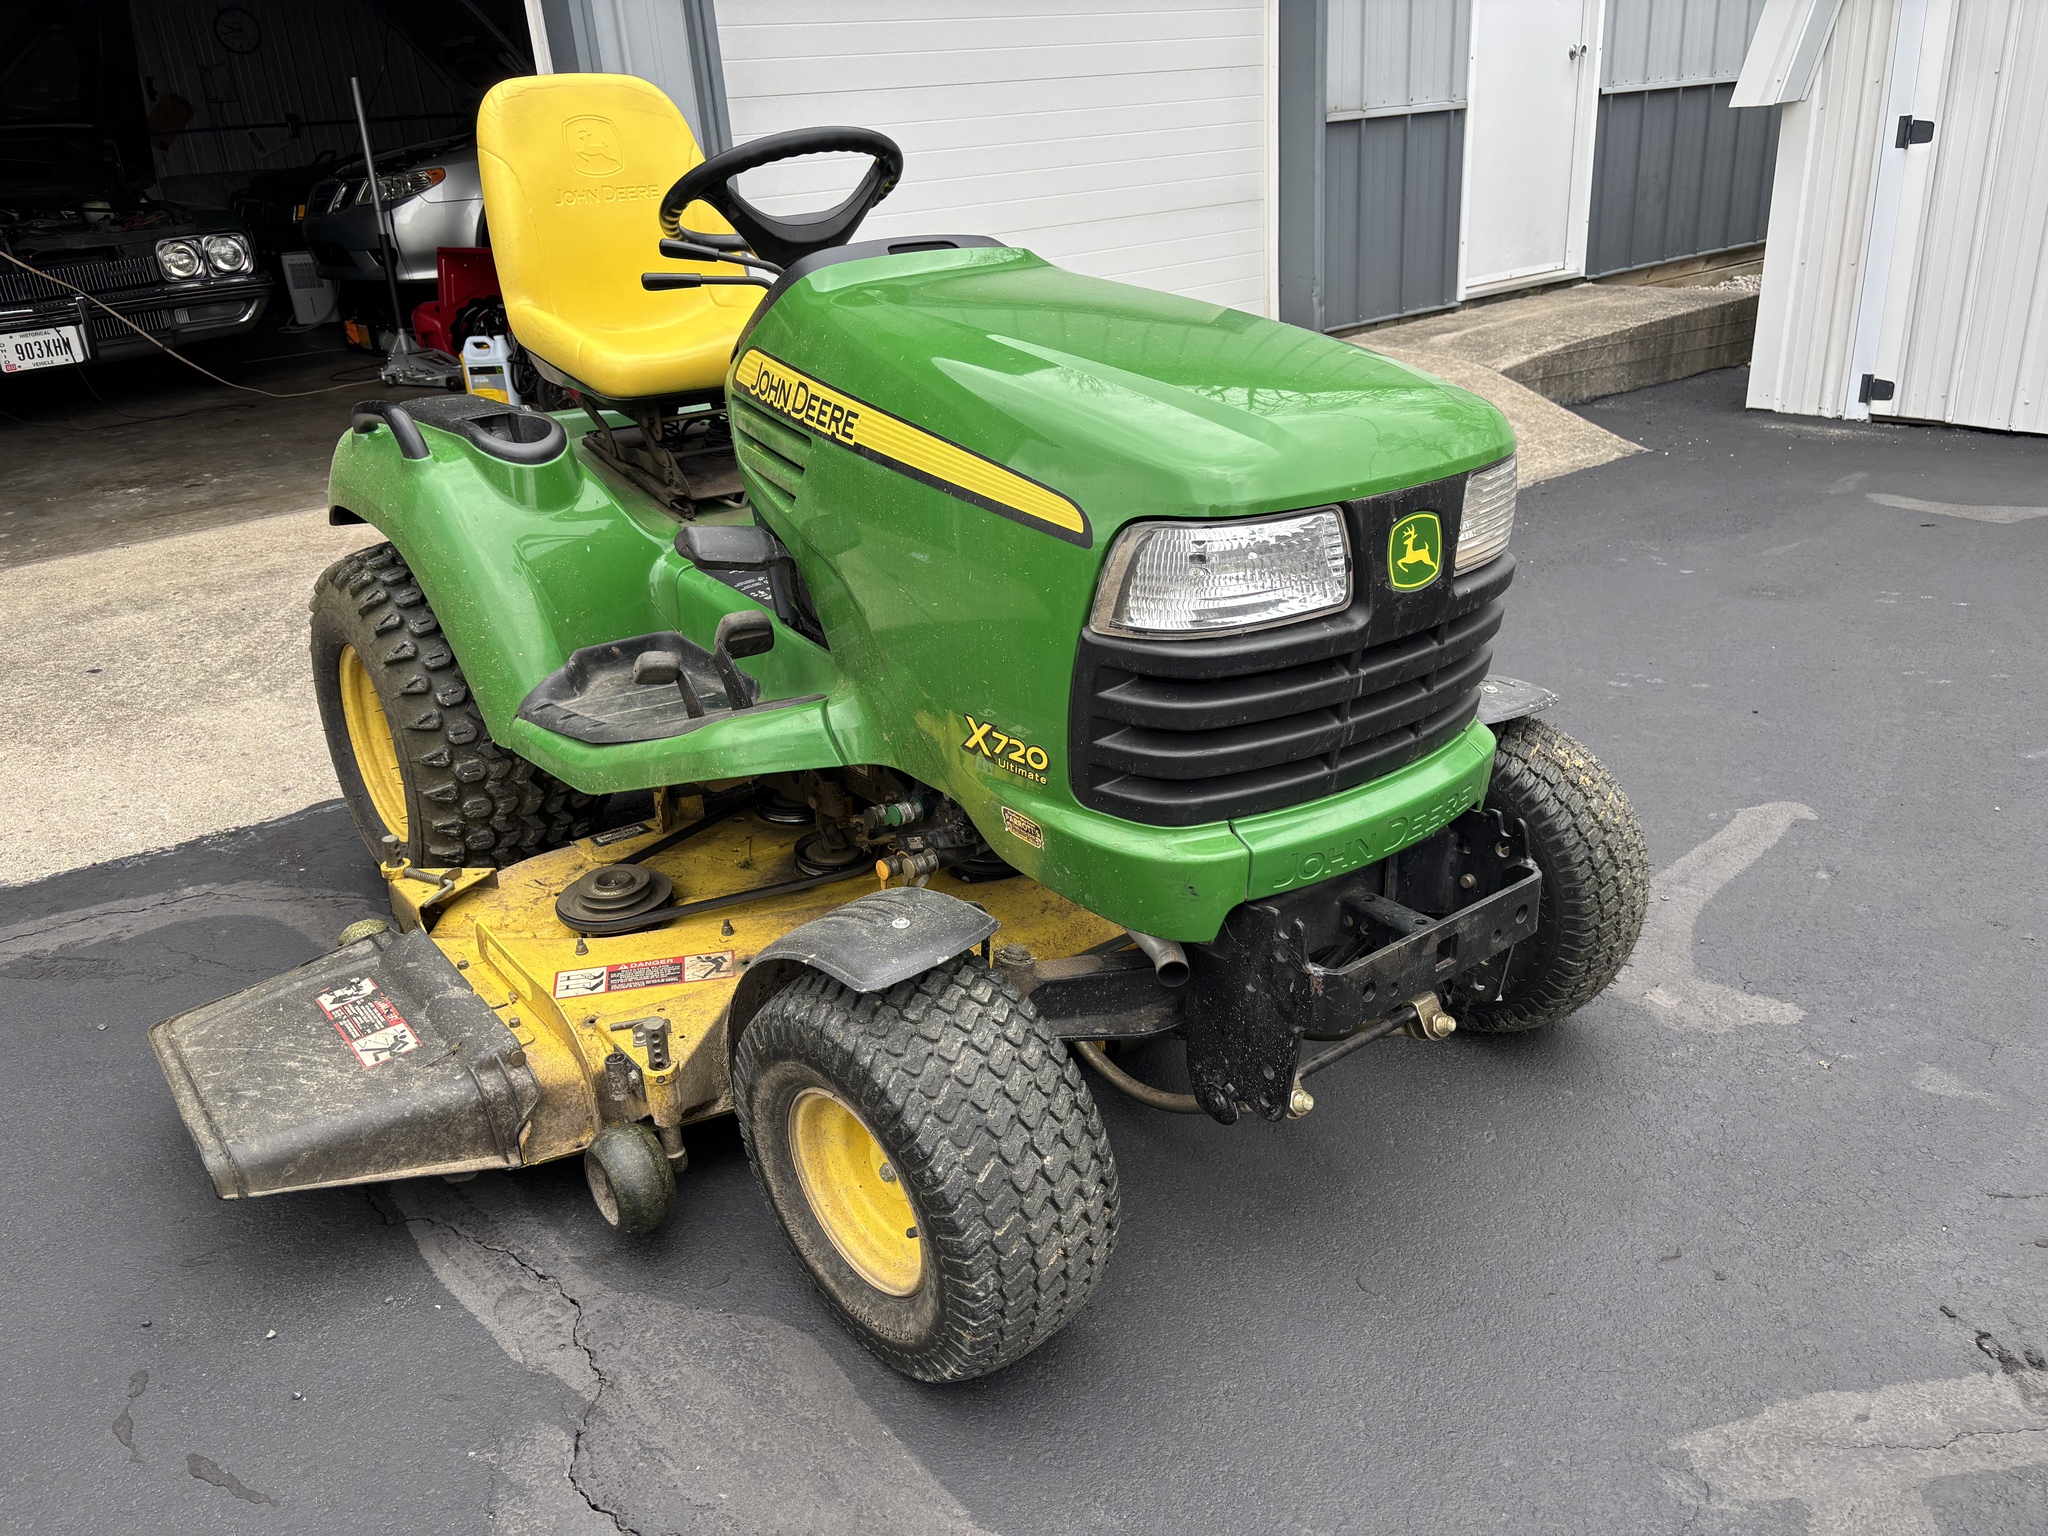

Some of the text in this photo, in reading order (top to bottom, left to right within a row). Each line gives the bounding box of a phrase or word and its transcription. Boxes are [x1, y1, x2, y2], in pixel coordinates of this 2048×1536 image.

[555, 184, 661, 207] JOHN DEERE
[19, 330, 51, 339] HISTORICAL
[32, 359, 55, 367] VEHICLE
[750, 361, 859, 441] JOHN DEERE
[961, 713, 1050, 773] X720
[998, 758, 1048, 785] Ultimate
[1273, 785, 1473, 889] JOHN DEERE
[630, 958, 674, 969] DANGER
